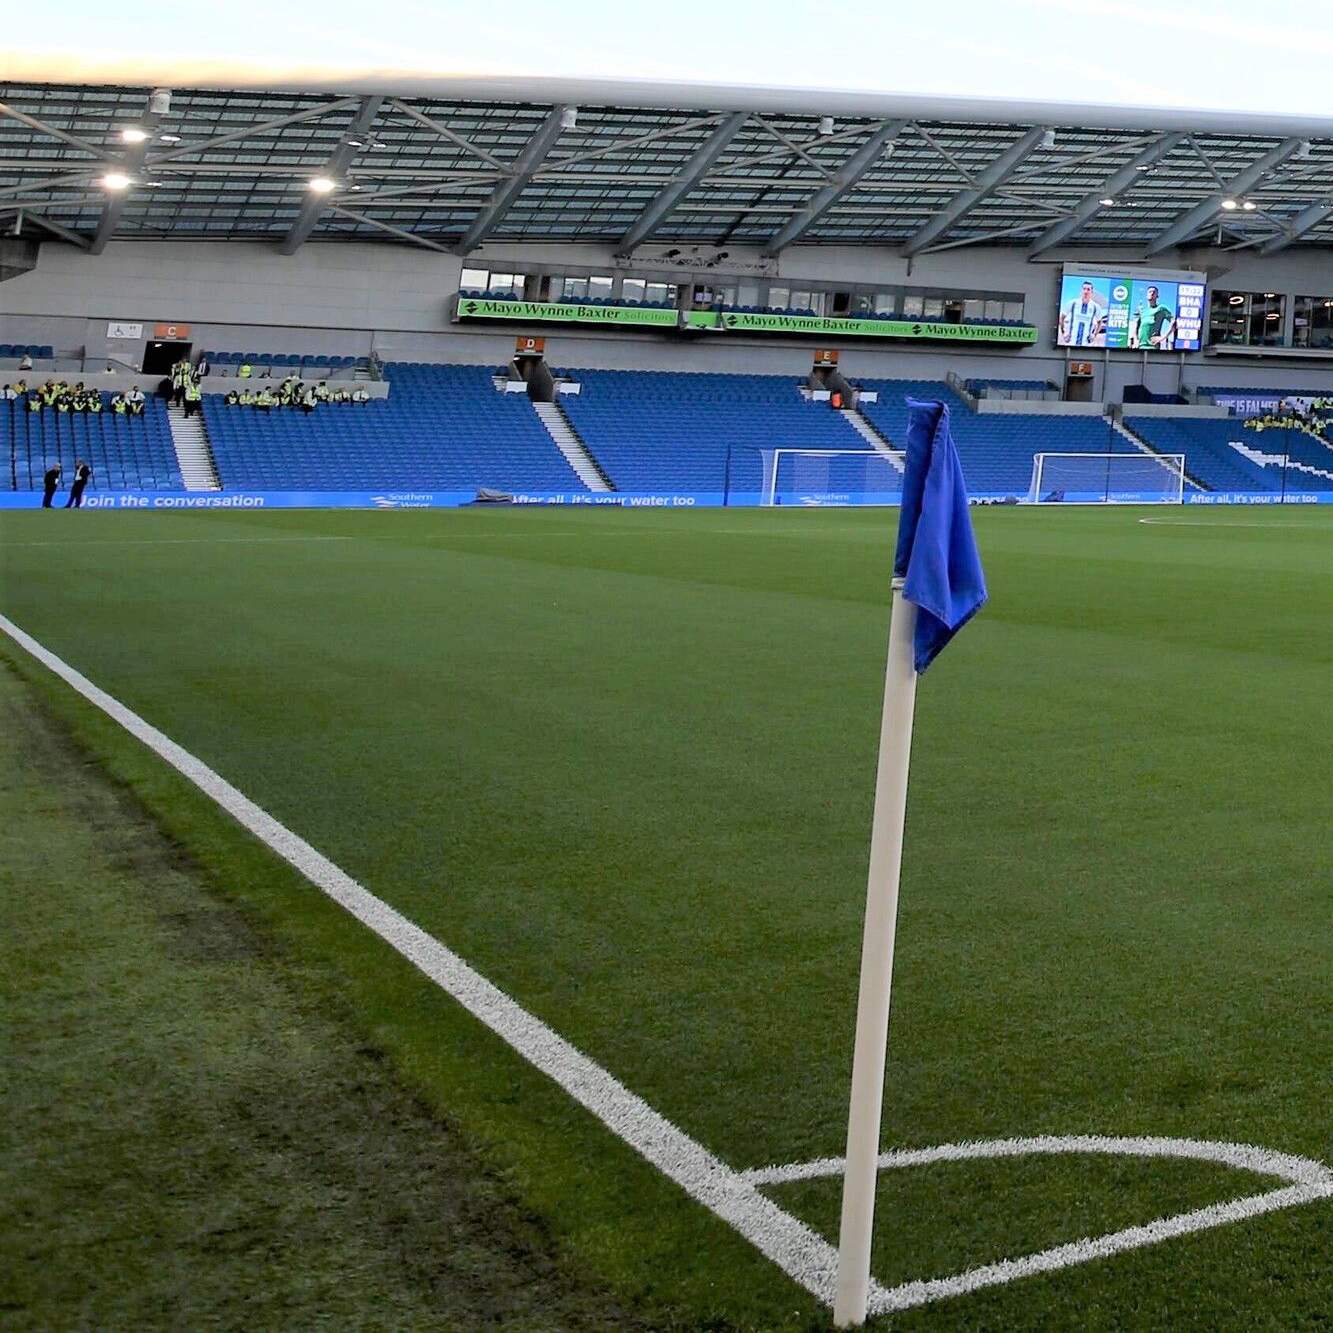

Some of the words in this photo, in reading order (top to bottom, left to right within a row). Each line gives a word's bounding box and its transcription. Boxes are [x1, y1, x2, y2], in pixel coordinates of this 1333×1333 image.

[1180, 296, 1200, 307] BHA
[483, 301, 522, 316] Mayo
[524, 304, 575, 319] Wynne
[577, 306, 620, 319] Baxter
[624, 311, 675, 322] Solicitors
[742, 315, 776, 329] Mayo
[778, 317, 821, 330] Wynne
[823, 319, 861, 331] Baxter
[1177, 318, 1201, 329] WHU
[168, 326, 177, 336] C
[926, 324, 957, 337] Mayo
[958, 325, 998, 338] Wynne
[999, 327, 1034, 339] Baxter
[526, 339, 535, 348] D
[824, 351, 830, 360] E
[80, 495, 115, 507] Join
[120, 495, 149, 507] the
[153, 495, 265, 508] conversation
[388, 493, 433, 501] Southern
[630, 495, 669, 506] water
[673, 495, 695, 506] too
[1189, 494, 1214, 504] After
[1249, 496, 1272, 505] your
[1302, 494, 1318, 504] too
